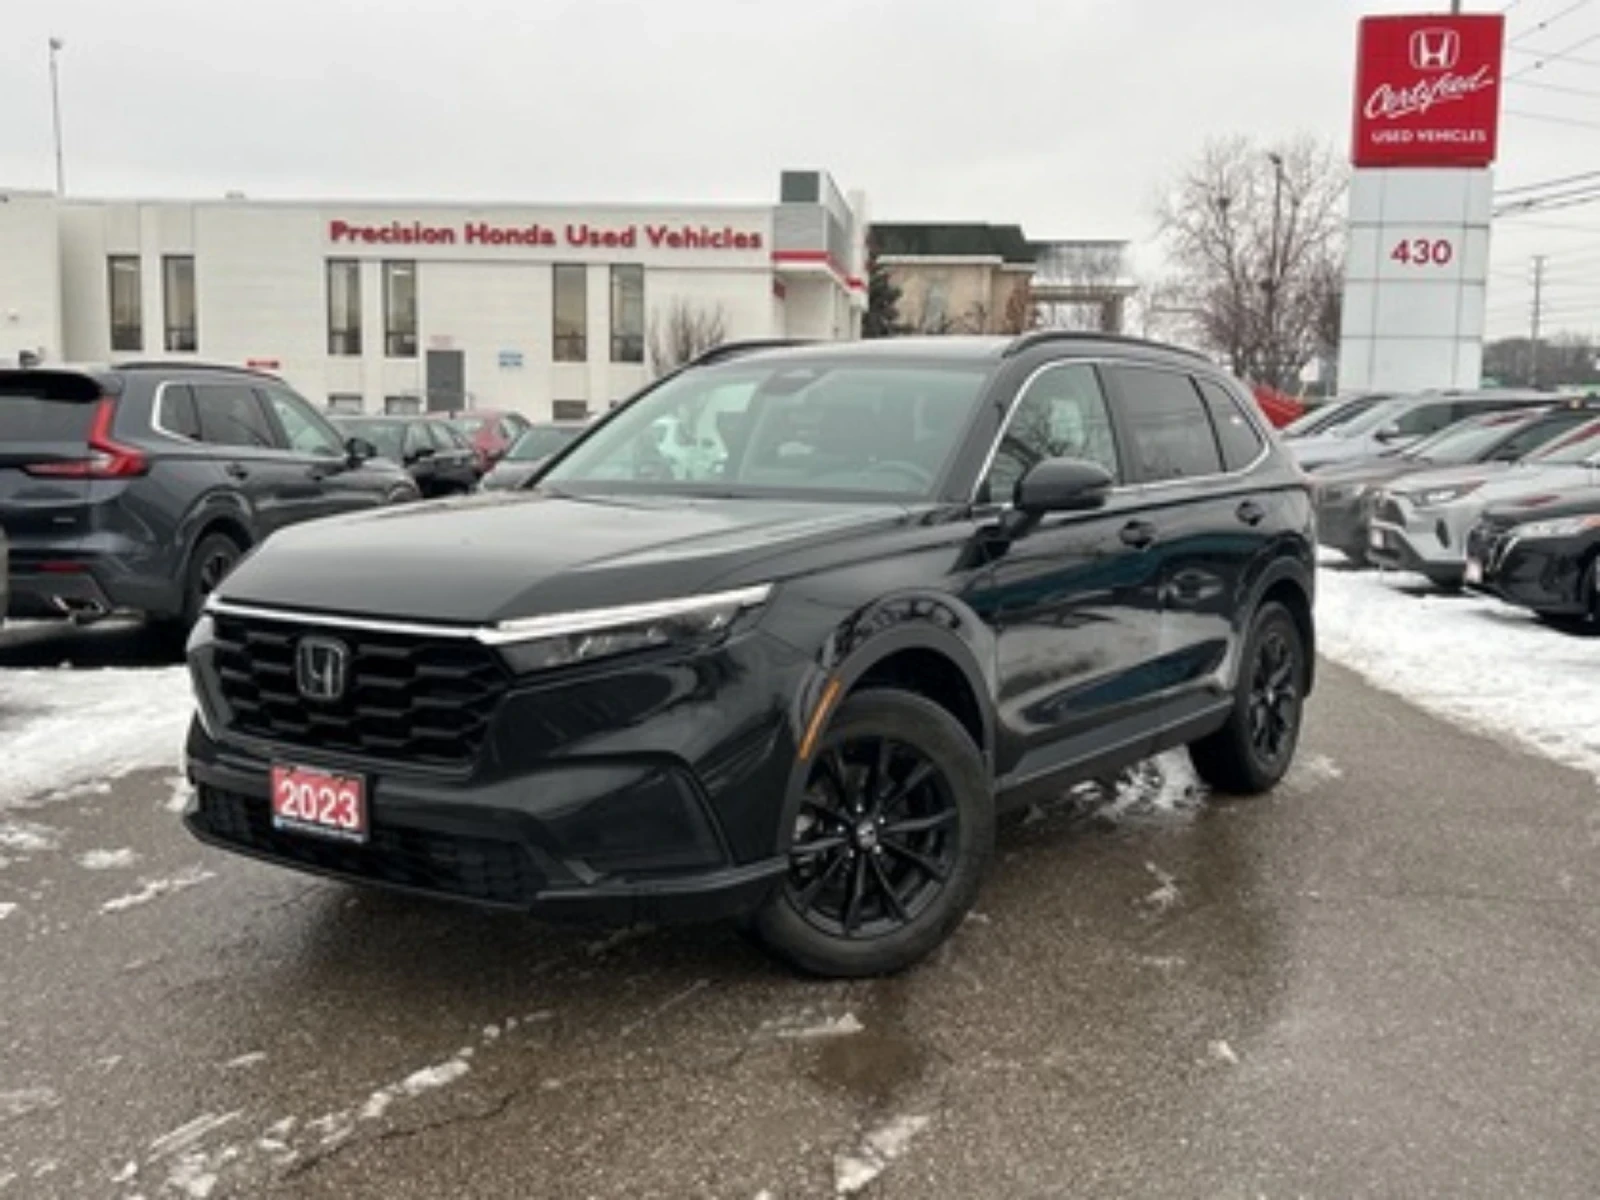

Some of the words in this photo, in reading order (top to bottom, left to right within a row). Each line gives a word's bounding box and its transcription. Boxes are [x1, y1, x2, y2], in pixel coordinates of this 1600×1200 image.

[1364, 64, 1494, 119] Certified
[1372, 129, 1413, 143] USED
[1417, 129, 1487, 143] VEHICLES
[330, 220, 456, 245] Precision
[464, 222, 557, 247] Honda
[566, 223, 636, 248] Used
[645, 225, 763, 250] Vehicles
[1391, 239, 1452, 265] 430
[281, 779, 359, 828] 2023
